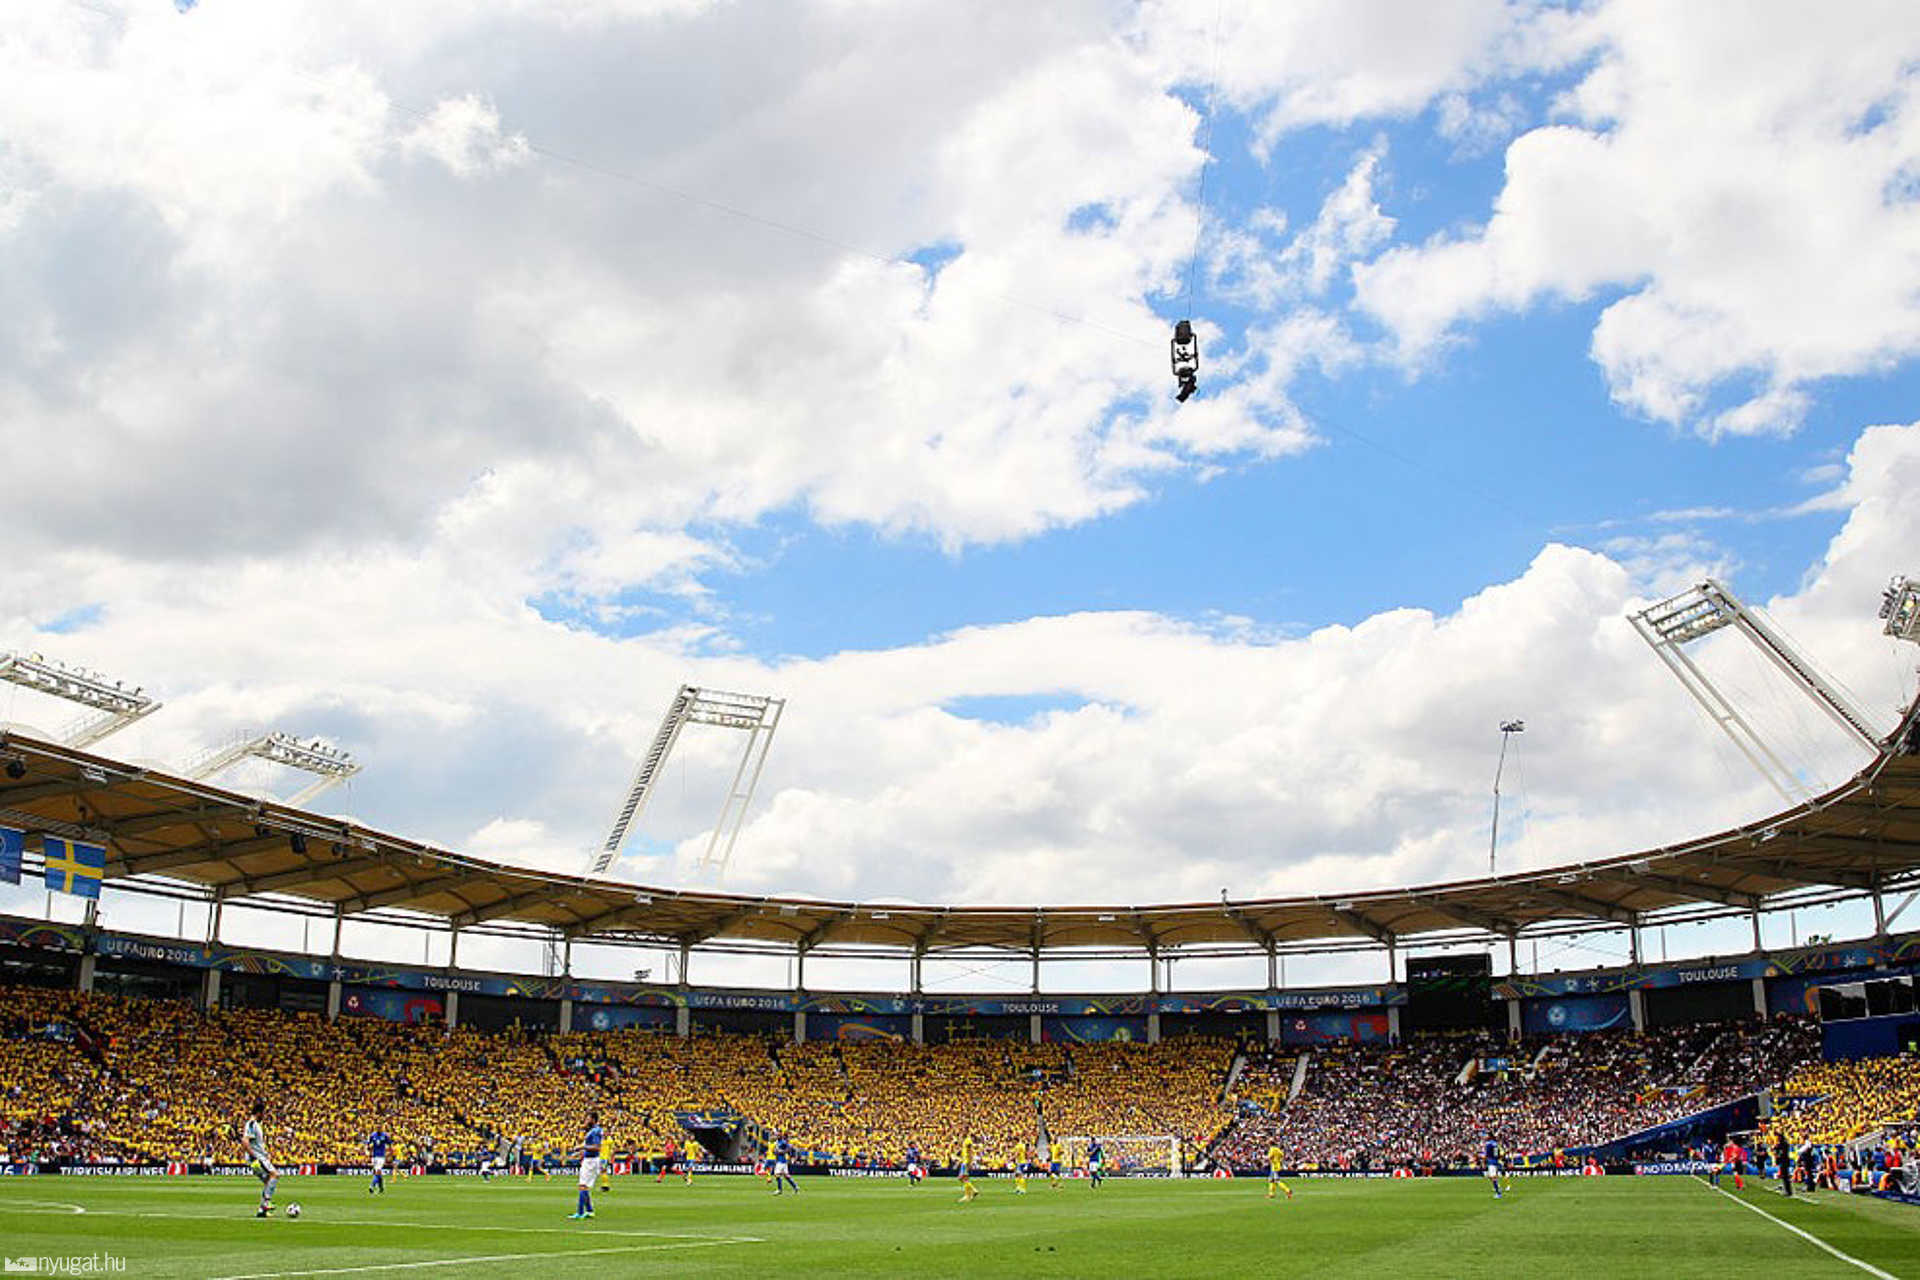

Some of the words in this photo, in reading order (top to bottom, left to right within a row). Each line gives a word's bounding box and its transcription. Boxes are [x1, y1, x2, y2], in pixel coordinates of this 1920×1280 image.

[167, 948, 197, 962] 2016
[1679, 966, 1738, 983] TOULOUSE
[424, 975, 481, 991] TOULOUSE
[696, 995, 725, 1006] UEFA
[726, 997, 757, 1008] EURO
[1276, 995, 1306, 1006] UEFA
[1308, 995, 1340, 1005] EURO
[1002, 1002, 1059, 1014] TOULOUSE
[59, 1167, 114, 1176] TURKISH
